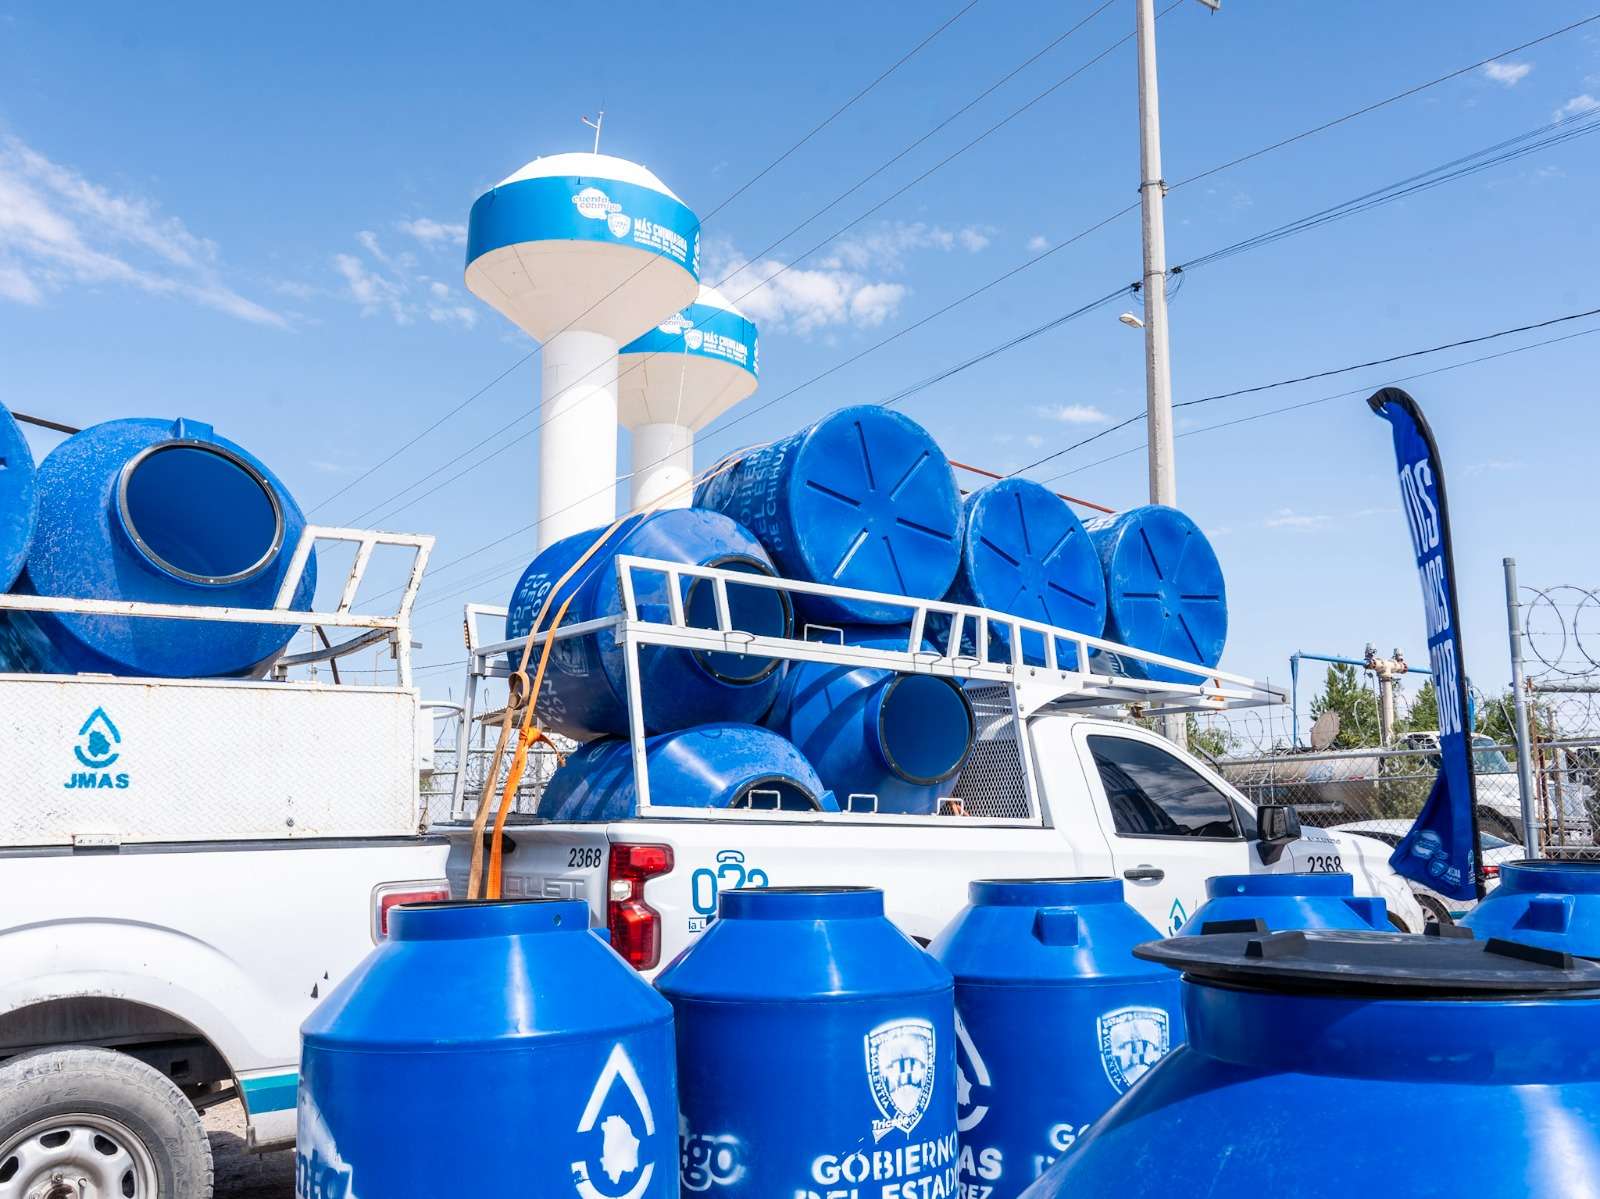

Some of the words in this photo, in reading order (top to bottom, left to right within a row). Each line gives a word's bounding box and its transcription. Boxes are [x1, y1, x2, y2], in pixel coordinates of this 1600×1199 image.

[64, 772, 129, 789] JMAS
[568, 847, 602, 868] 2368
[1307, 855, 1345, 873] 2368
[811, 1133, 959, 1185] GOBIERNO
[958, 1145, 1003, 1180] AS
[881, 1167, 959, 1199] ESTAD
[958, 1183, 994, 1199] REZ
